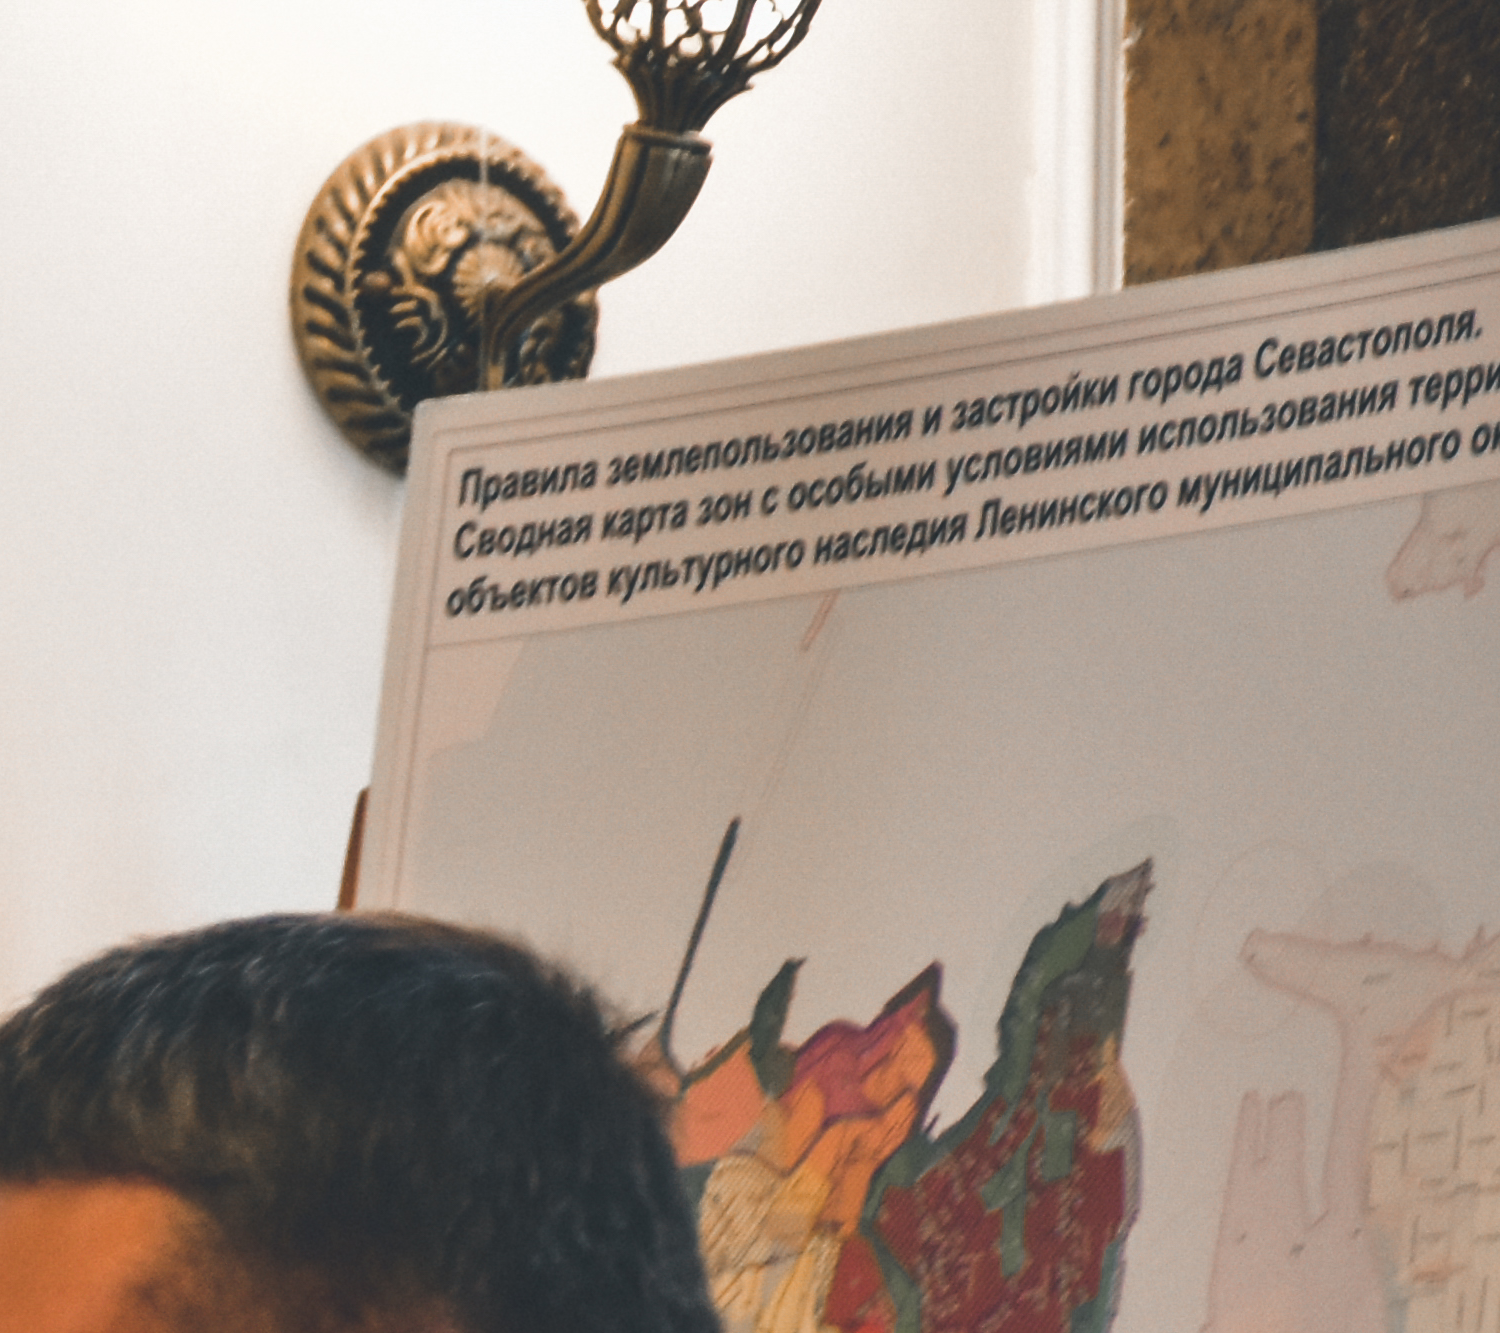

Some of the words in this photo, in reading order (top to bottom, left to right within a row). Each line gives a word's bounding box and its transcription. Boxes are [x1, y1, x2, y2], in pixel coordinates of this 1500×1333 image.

[454, 512, 593, 560] Сводная
[601, 498, 690, 545] карта
[696, 488, 753, 527] зон
[760, 484, 780, 517] с
[787, 459, 937, 514] особыми
[943, 427, 1129, 498] условиями
[1136, 378, 1400, 456] использования
[458, 460, 598, 513] Правила
[606, 408, 914, 487] землепользования
[921, 404, 943, 437] и
[950, 370, 1120, 431] застройки
[1127, 352, 1244, 405] города
[1254, 307, 1483, 379] Севастополя.
[445, 569, 599, 618] объектов
[606, 536, 806, 606] культурного
[813, 512, 969, 566] наследия
[974, 479, 1169, 543] Ленинского
[1176, 427, 1462, 515] муниципального
